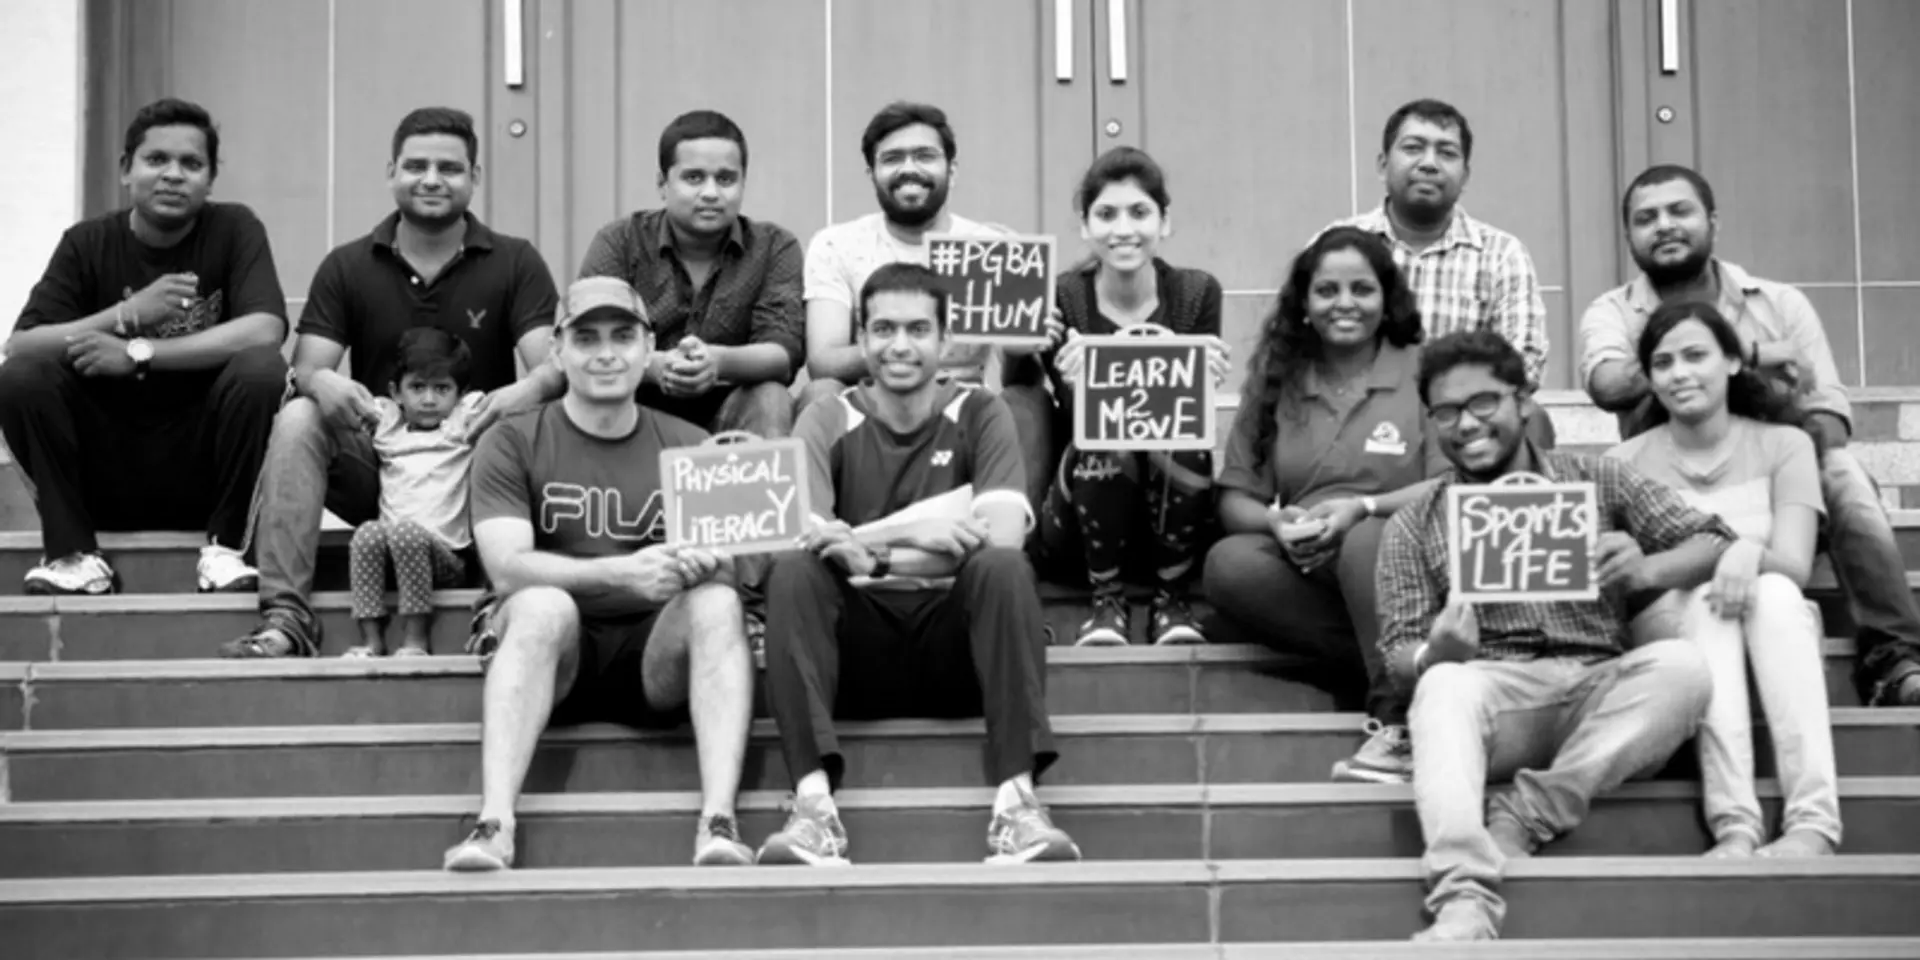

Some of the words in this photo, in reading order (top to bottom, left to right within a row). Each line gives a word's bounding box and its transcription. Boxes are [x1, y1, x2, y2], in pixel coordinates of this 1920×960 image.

[931, 240, 1044, 287] #PGBA
[1088, 347, 1196, 388] LEARN
[1126, 388, 1152, 418] 2
